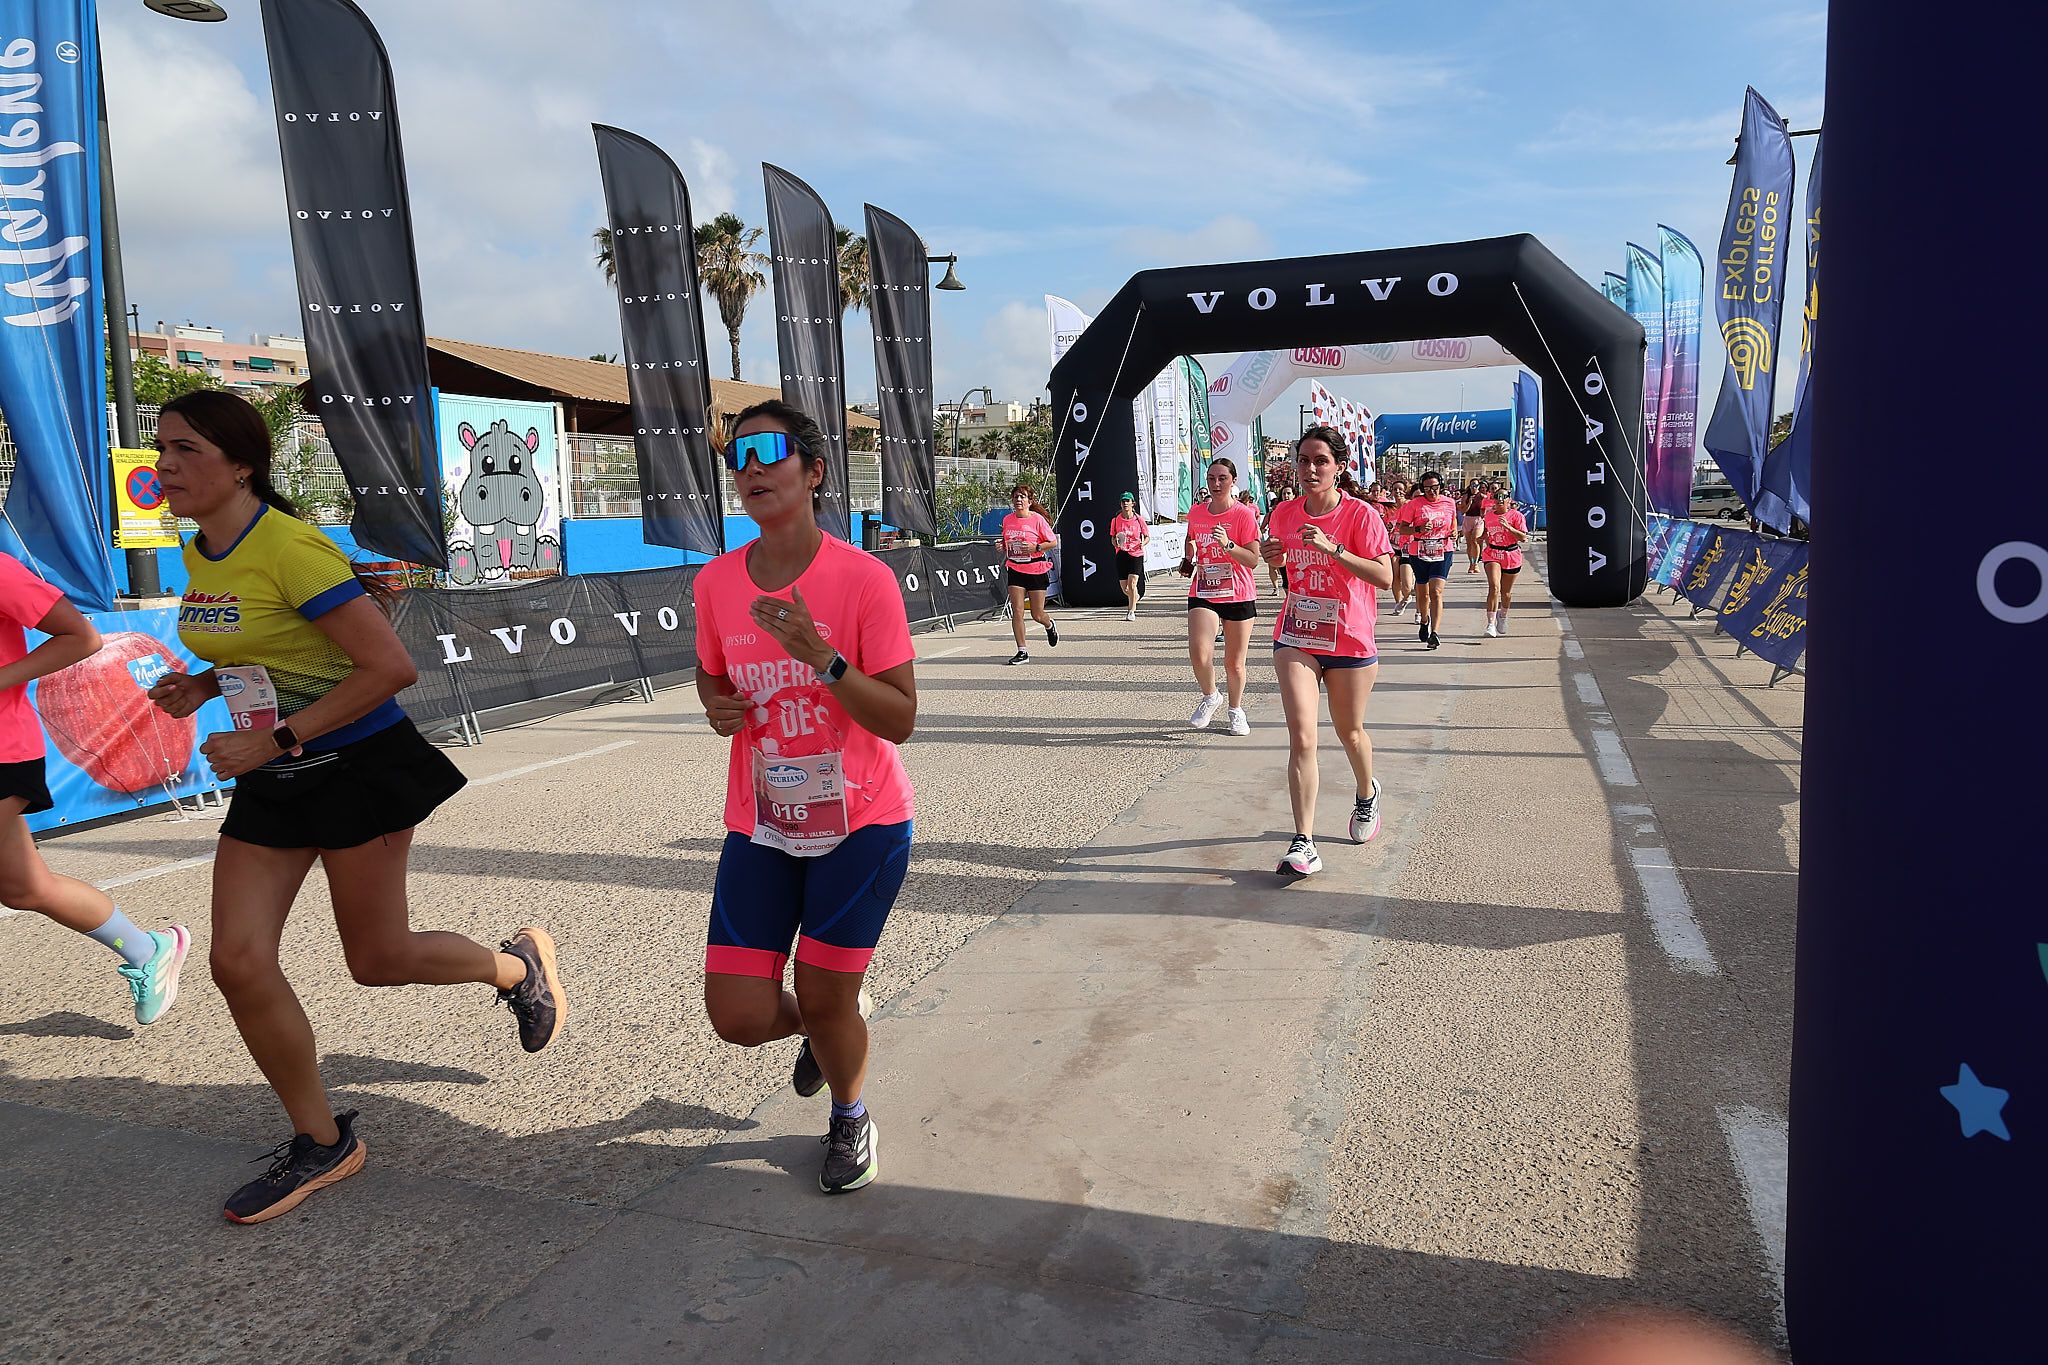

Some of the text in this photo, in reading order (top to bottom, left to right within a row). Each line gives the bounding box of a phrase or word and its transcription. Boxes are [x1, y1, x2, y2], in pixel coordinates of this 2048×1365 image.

[1187, 272, 1459, 314] VOLVO
[1294, 348, 1341, 366] COSMO
[1420, 414, 1478, 439] Marlene
[1584, 372, 1607, 576] VOLVO
[1072, 402, 1098, 582] VOLVO
[936, 564, 1000, 587] VOLV
[1310, 570, 1326, 591] DE
[179, 605, 241, 624] unners
[1295, 620, 1318, 630] 016
[436, 617, 577, 665] LVO
[233, 713, 252, 729] 16
[779, 698, 815, 738] DE
[766, 772, 805, 783] ASTURIANA
[772, 802, 809, 821] 016
[802, 842, 838, 851] Santander
